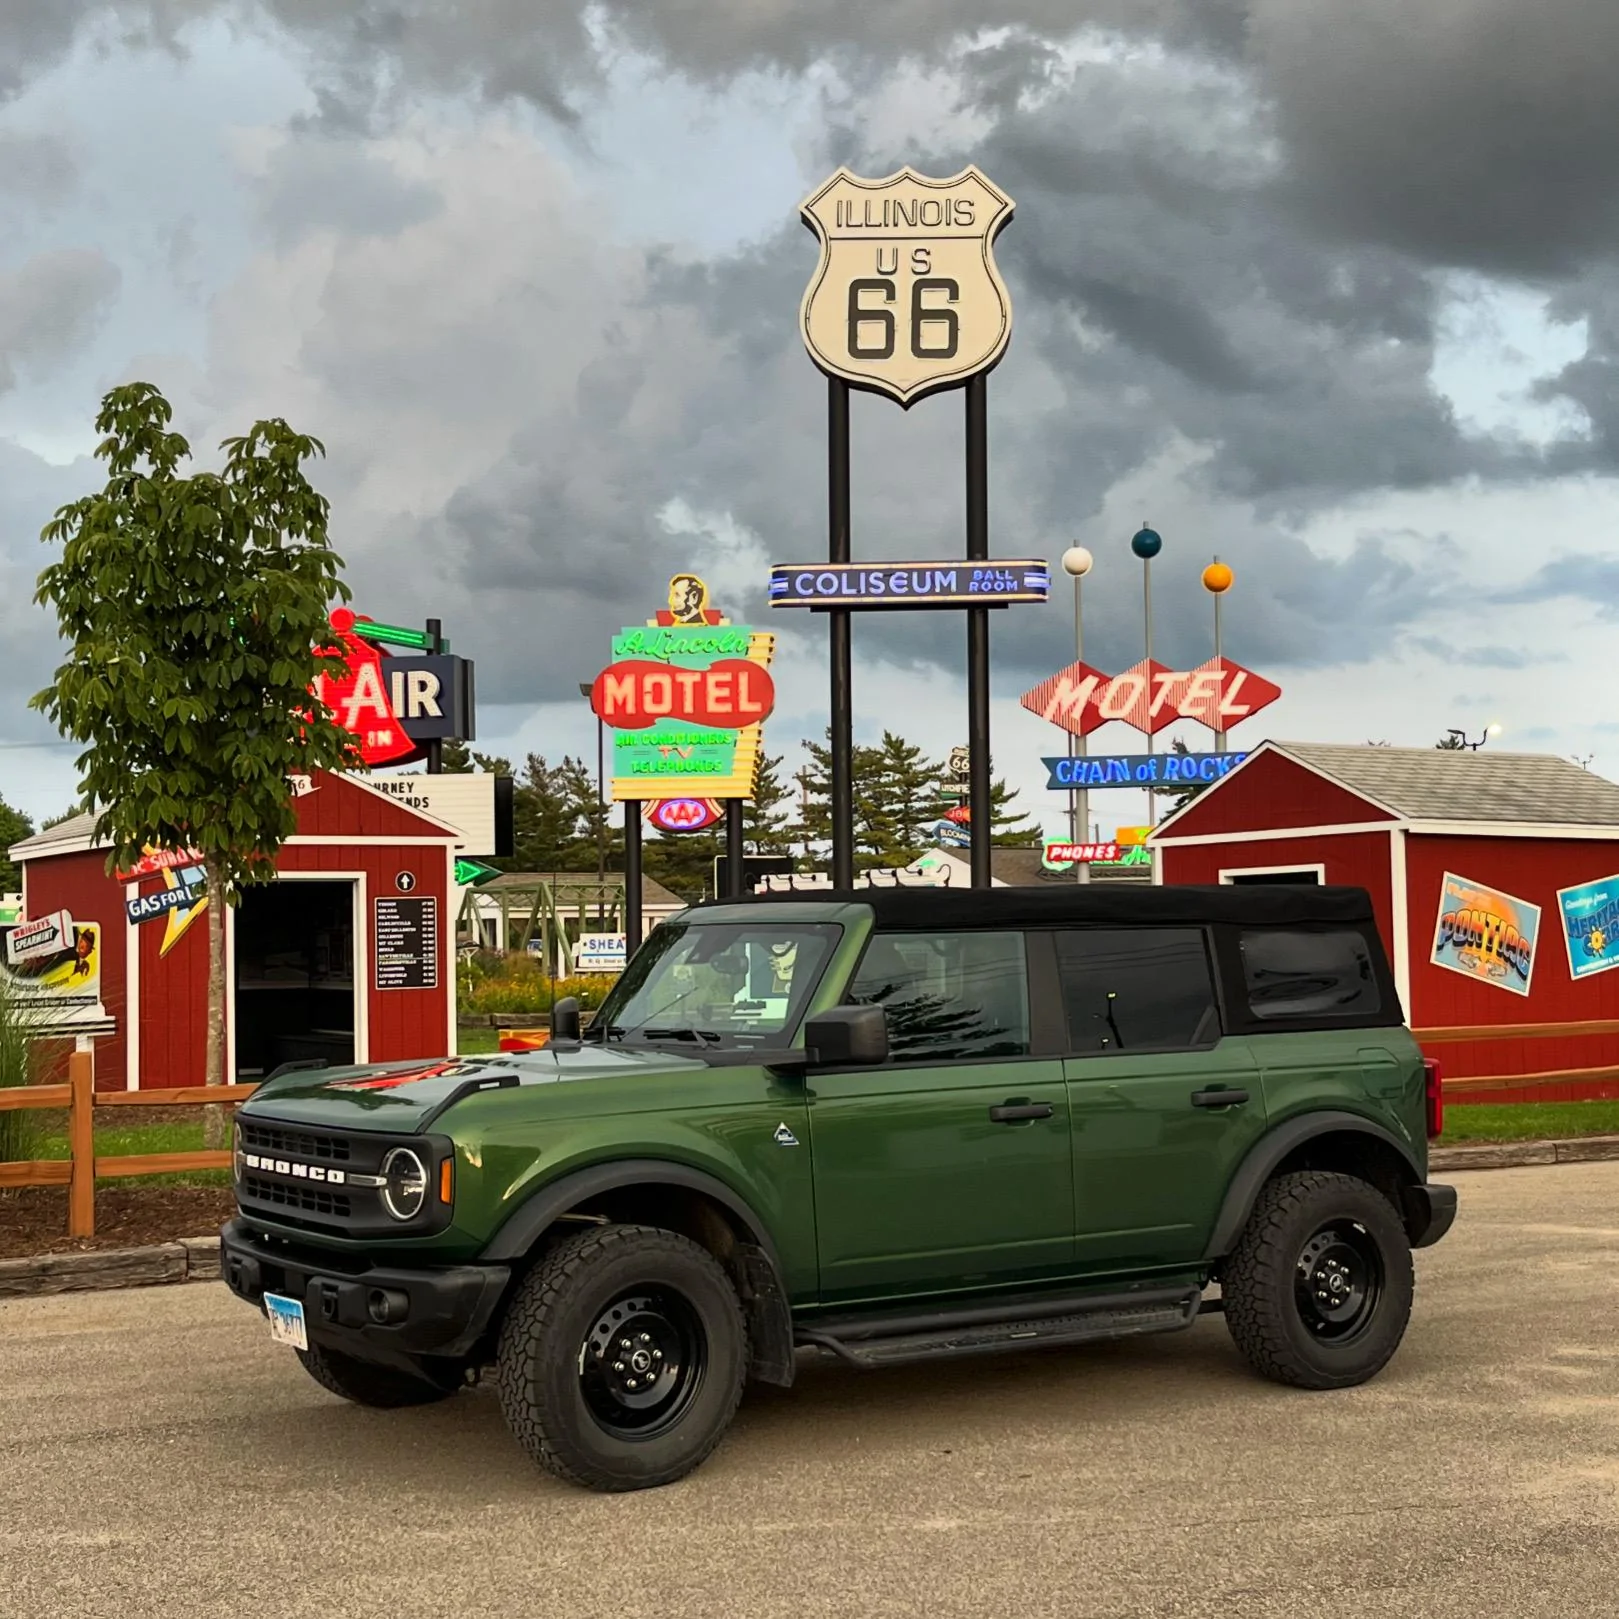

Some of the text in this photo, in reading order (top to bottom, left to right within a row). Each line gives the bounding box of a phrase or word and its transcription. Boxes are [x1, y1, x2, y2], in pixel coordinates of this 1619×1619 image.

[836, 199, 975, 228] ILLINOIS
[847, 278, 961, 360] 66
[795, 570, 957, 596] COLISEUM
[968, 581, 1018, 592] ROOM
[973, 570, 1013, 581] BALL
[645, 629, 749, 661] Lincoln
[603, 671, 763, 715] MOTEL
[1043, 670, 1251, 721] MOTEL
[367, 730, 393, 747] IN
[658, 746, 694, 759] TV
[952, 757, 970, 770] 66
[631, 760, 723, 773] TELEPHONES
[1056, 758, 1131, 784] CHAIN
[1135, 758, 1158, 782] of
[369, 782, 414, 794] URNEY
[397, 797, 429, 808] NDS
[665, 801, 700, 824] AAA
[1050, 844, 1117, 860] PHONES
[129, 895, 161, 916] GAS
[161, 889, 186, 906] FOR
[15, 928, 54, 951] SPEARMINT
[1437, 908, 1532, 981] PONTIAC
[246, 1154, 345, 1184] BRONCO
